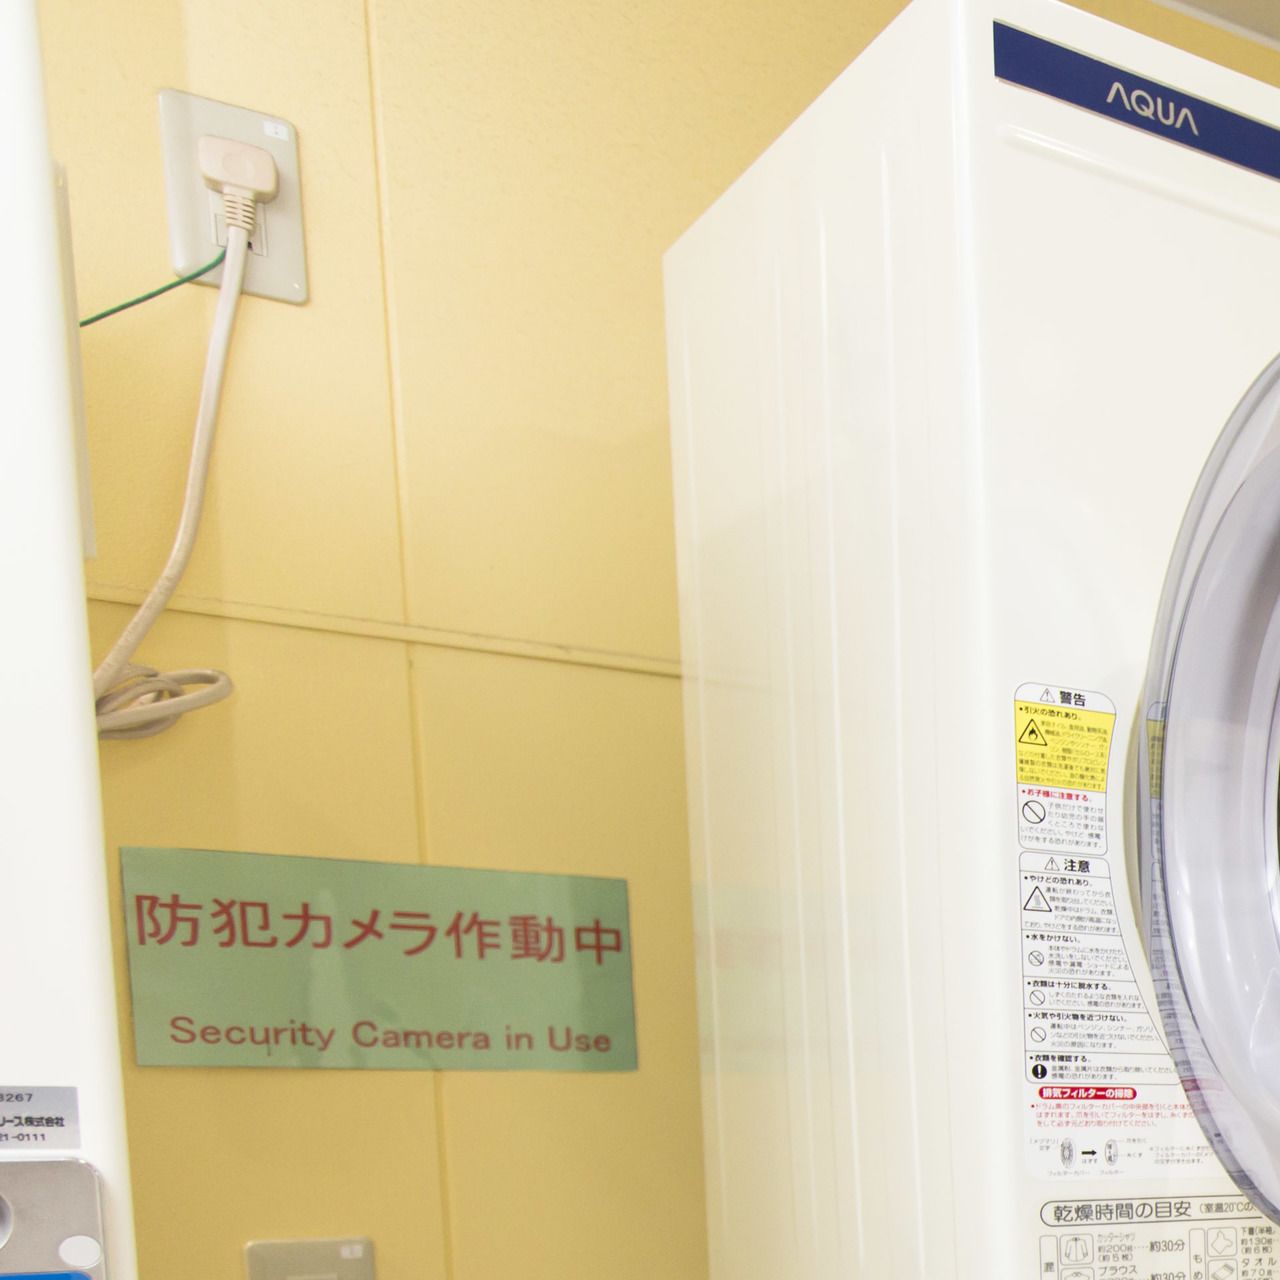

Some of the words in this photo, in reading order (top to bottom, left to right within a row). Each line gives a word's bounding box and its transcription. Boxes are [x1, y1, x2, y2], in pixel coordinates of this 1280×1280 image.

[1106, 81, 1199, 136] AQUA
[1060, 690, 1086, 707] 警告
[1064, 858, 1090, 873] 注意
[135, 893, 622, 965] 防犯カメラ作動中
[170, 1016, 336, 1052] Security
[352, 1020, 491, 1051] Camera
[506, 1024, 534, 1051] in
[549, 1026, 612, 1053] Use
[1053, 1200, 1192, 1223] 乾燥時間の目安
[1149, 1239, 1186, 1252] 約30分
